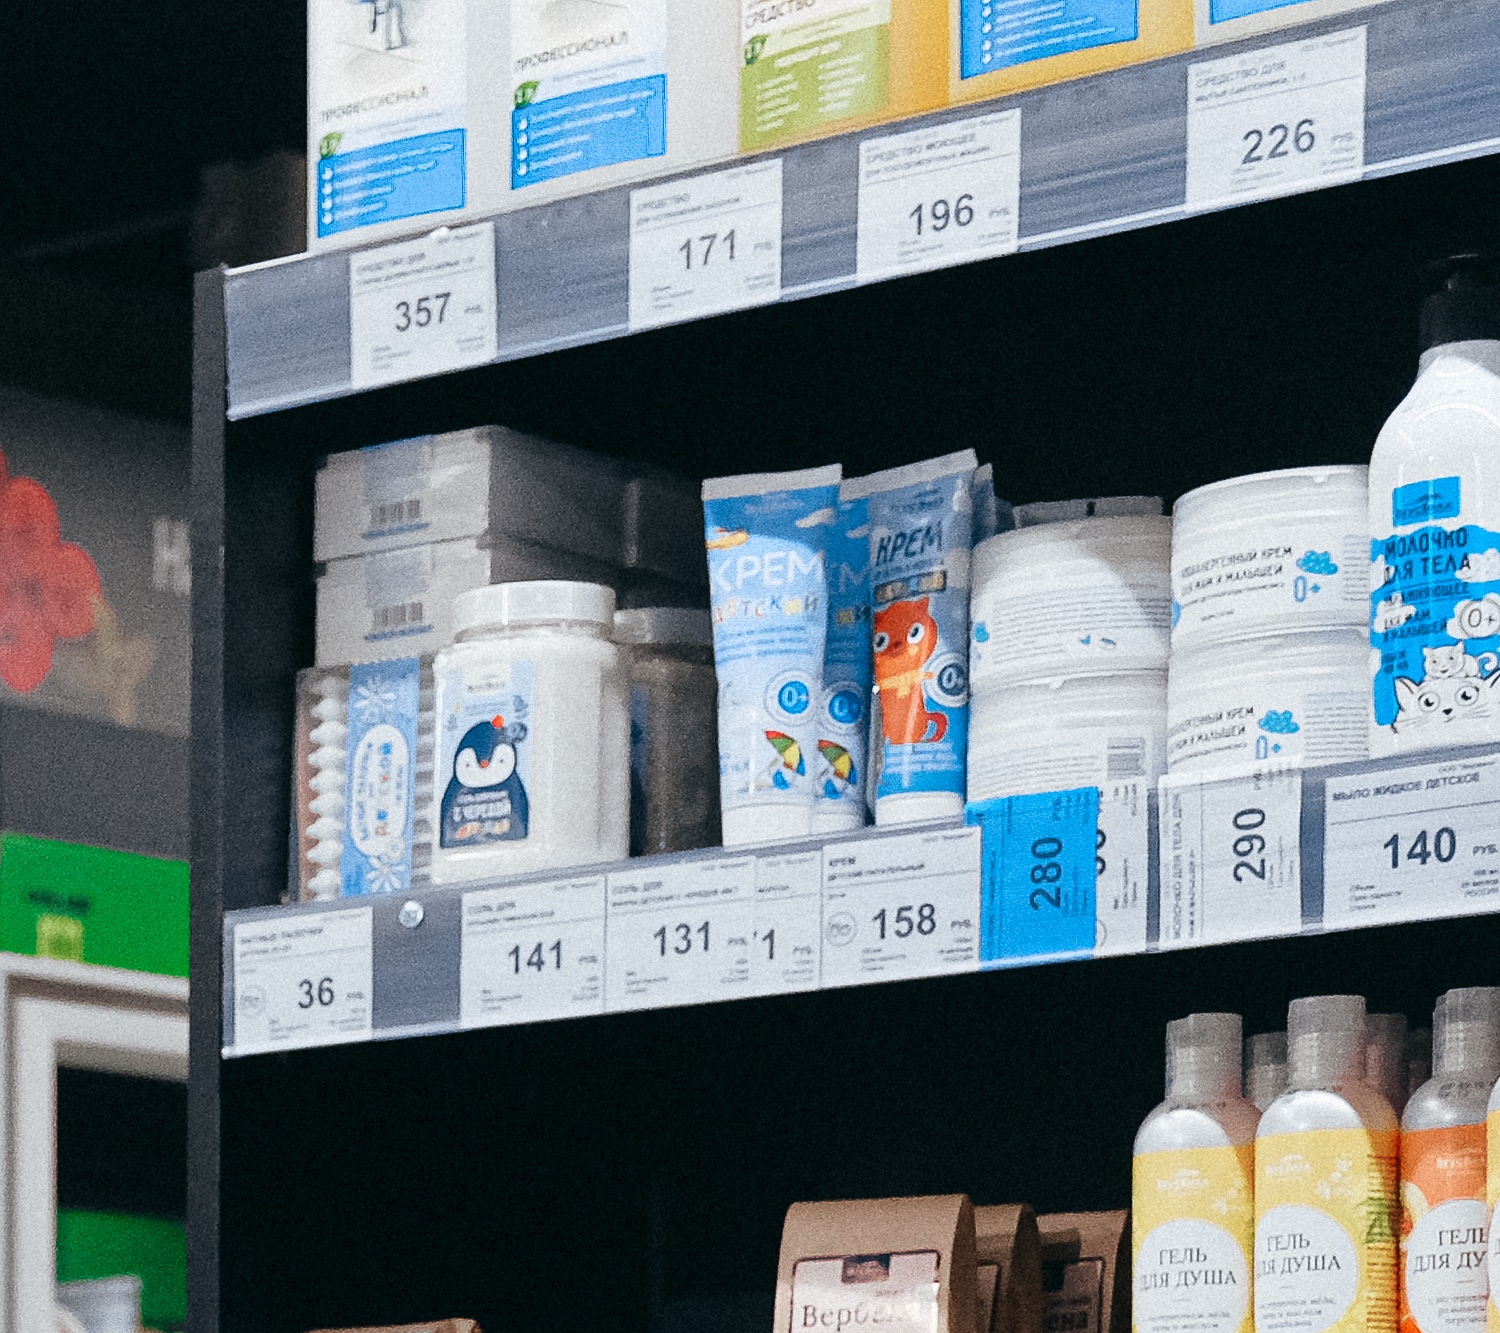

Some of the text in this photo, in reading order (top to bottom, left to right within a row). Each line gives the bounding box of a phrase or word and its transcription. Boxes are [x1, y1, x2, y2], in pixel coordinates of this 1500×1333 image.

[1242, 118, 1316, 165] 226
[909, 193, 975, 236] 196
[678, 229, 737, 270] 171
[395, 292, 451, 332] 357
[876, 525, 943, 565] КРЕМ
[1384, 527, 1468, 559] МОЛОЧКО
[713, 550, 825, 591] КРЕМ
[1420, 551, 1471, 579] ТЕЛА
[1233, 808, 1266, 883] 290
[1383, 827, 1457, 869] 140
[1030, 835, 1063, 911] 280
[652, 920, 712, 957] 131
[872, 902, 937, 939] 158
[506, 939, 564, 975] 141
[297, 976, 336, 1010] 36
[1158, 1247, 1208, 1266] ГЕЛЬ
[1266, 1233, 1311, 1252] ГЕЛЬ
[1139, 1269, 1238, 1292] ДЛЯ ДУША
[1280, 1254, 1342, 1275] ДУША
[1412, 1254, 1451, 1275] ДЛЯ
